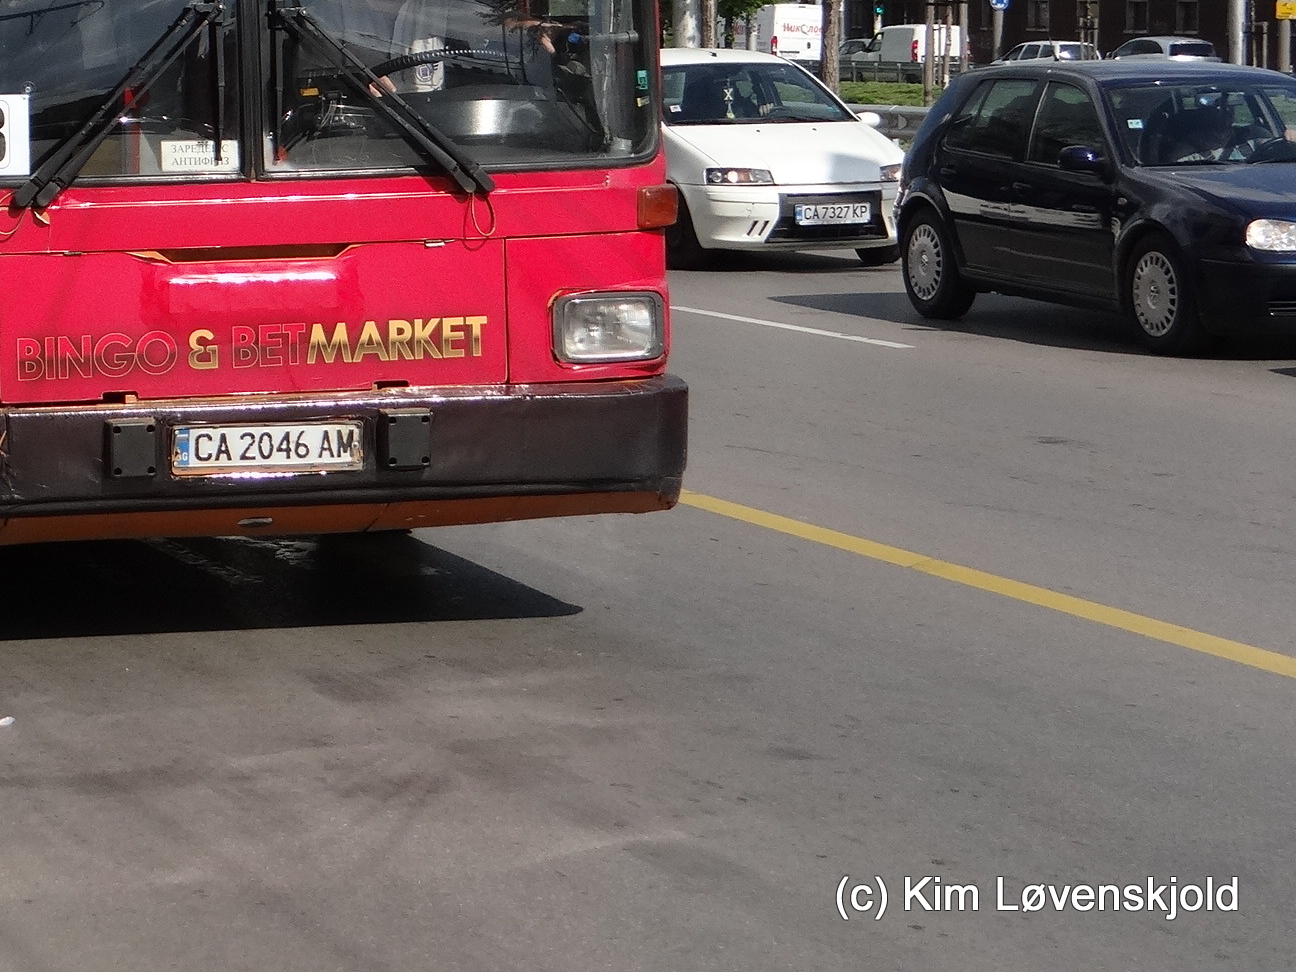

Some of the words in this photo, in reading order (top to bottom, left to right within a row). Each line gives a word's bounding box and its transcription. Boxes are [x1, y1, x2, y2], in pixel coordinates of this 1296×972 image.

[221, 143, 229, 153] С
[822, 206, 850, 220] 7327
[16, 330, 178, 381] BINGO
[188, 329, 219, 369] &
[194, 432, 232, 462] CA
[239, 430, 309, 461] 2046
[318, 429, 355, 458] AM
